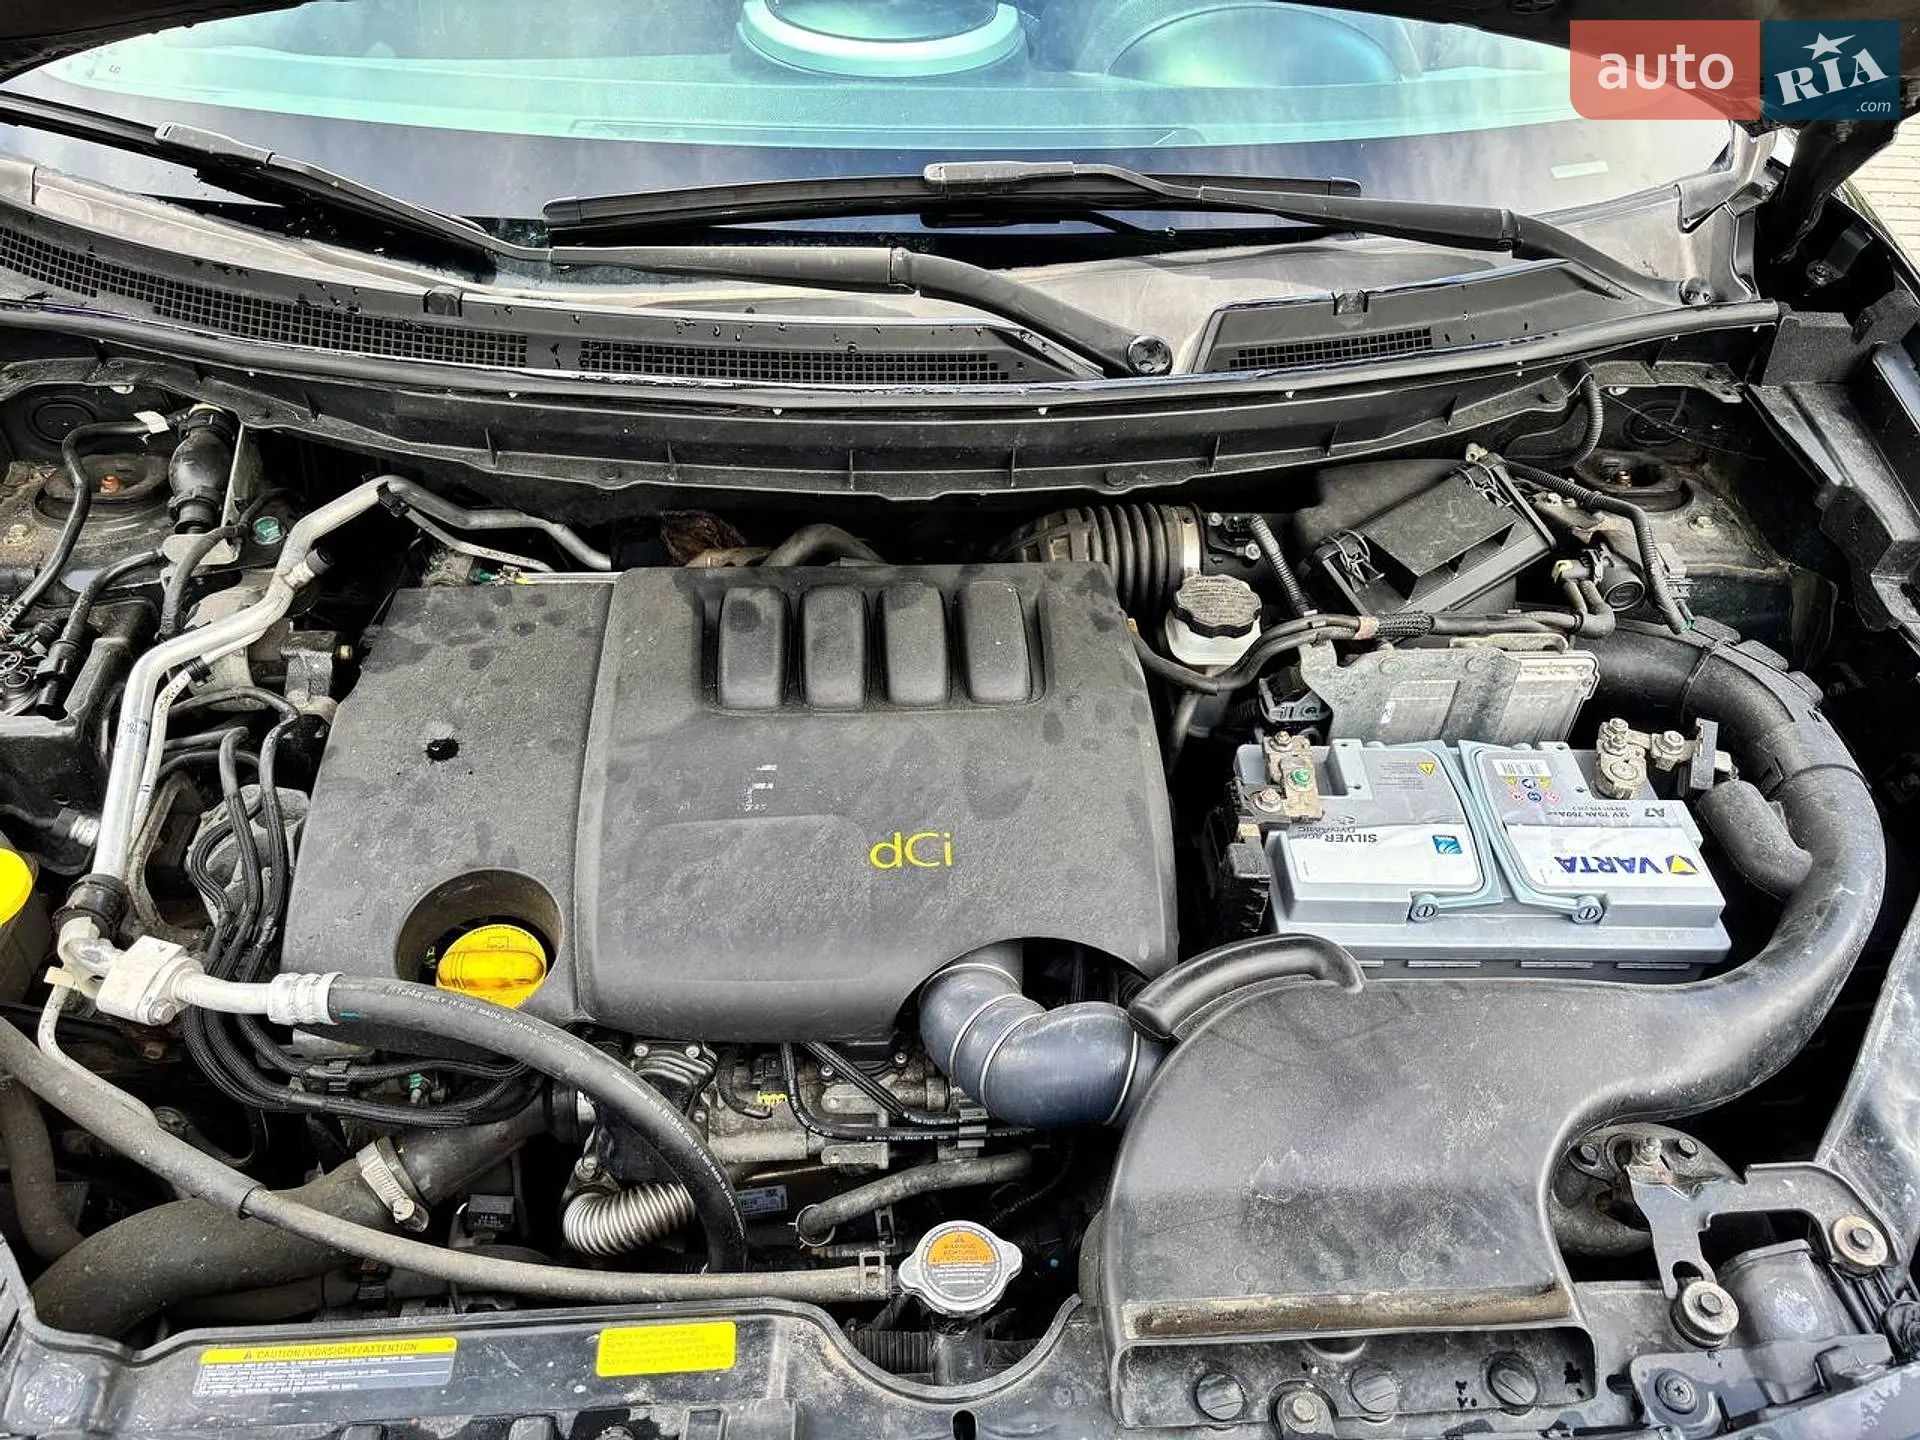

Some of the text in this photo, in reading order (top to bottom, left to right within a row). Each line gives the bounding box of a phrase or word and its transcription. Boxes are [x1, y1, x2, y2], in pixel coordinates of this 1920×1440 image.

[1325, 834, 1378, 843] SILVER
[869, 832, 953, 869] dCi
[1554, 856, 1663, 874] VARTA
